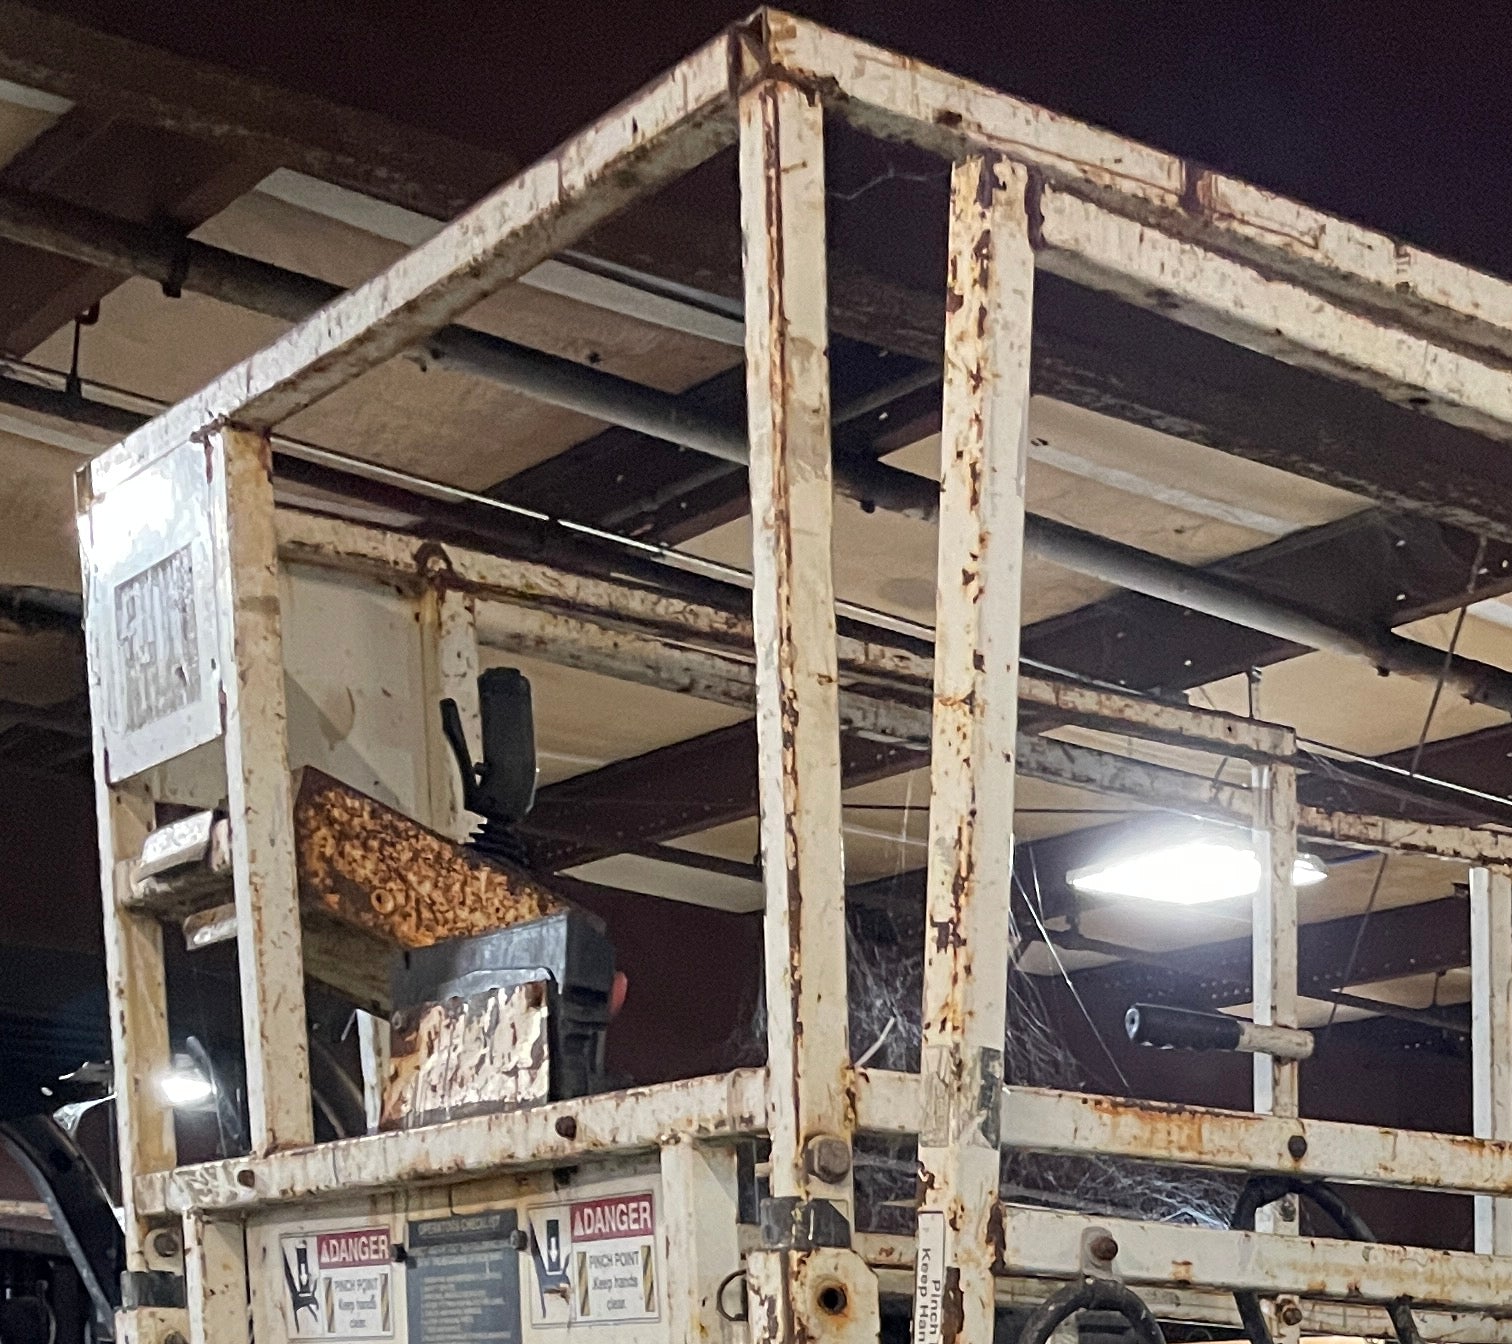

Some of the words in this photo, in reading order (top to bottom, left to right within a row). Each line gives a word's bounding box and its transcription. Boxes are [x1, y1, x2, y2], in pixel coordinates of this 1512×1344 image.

[583, 1201, 651, 1235] DANGER
[329, 1235, 389, 1262] DANGER
[589, 1255, 613, 1269] PINCH
[614, 1251, 639, 1266] POINT
[592, 1278, 613, 1292] Keep
[918, 1248, 931, 1297] Keep
